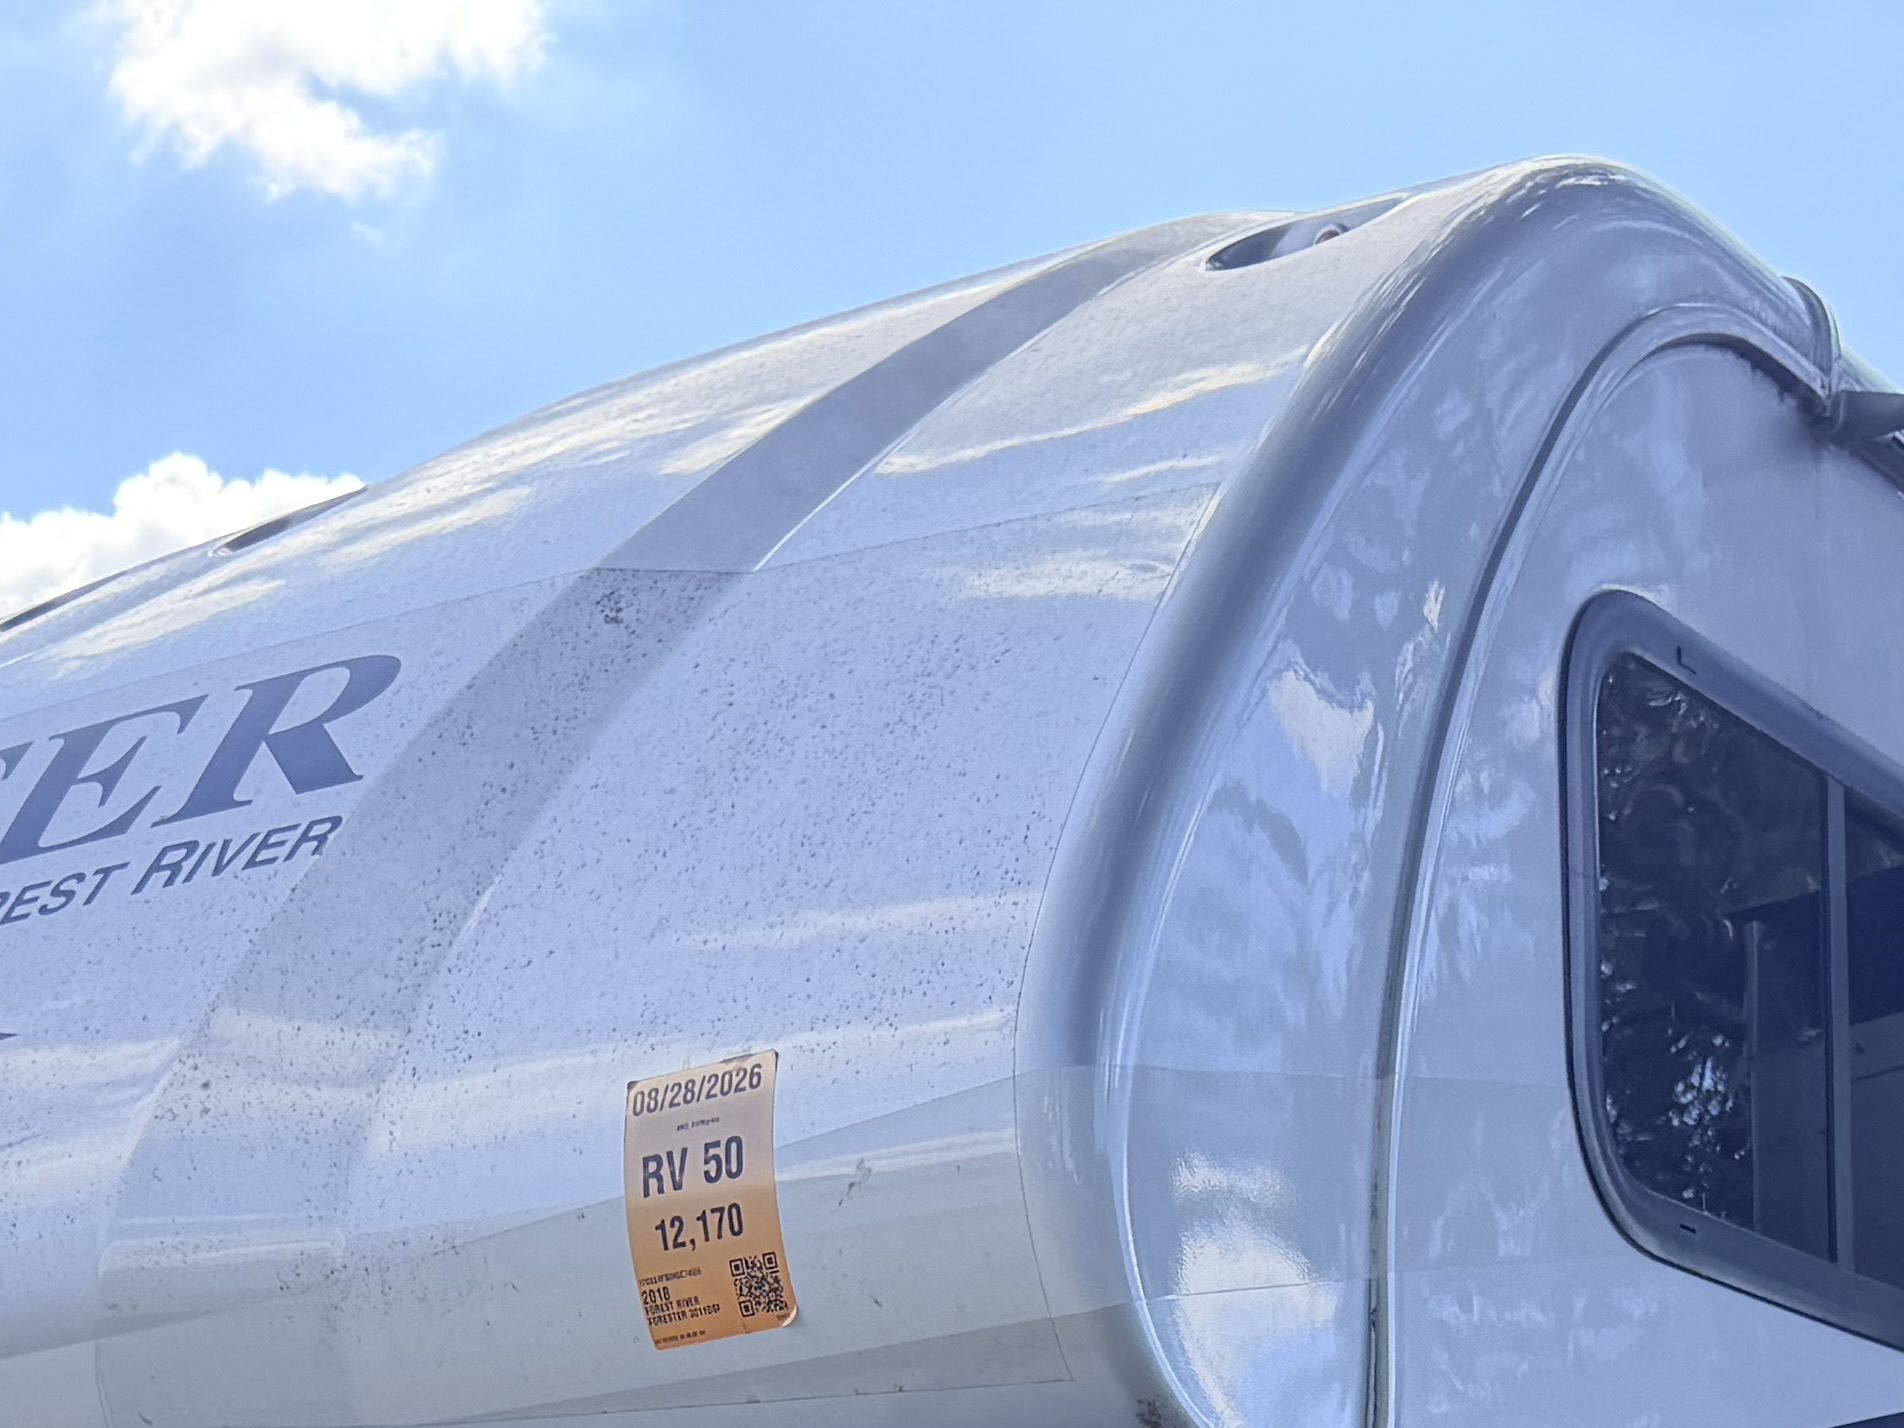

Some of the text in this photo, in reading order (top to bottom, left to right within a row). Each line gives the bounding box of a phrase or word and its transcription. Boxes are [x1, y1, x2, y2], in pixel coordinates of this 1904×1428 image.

[131, 812, 344, 900] RIVER
[632, 1063, 762, 1117] 08/28/2026
[641, 1135, 744, 1199] RV 50
[654, 1202, 744, 1252] 12,170
